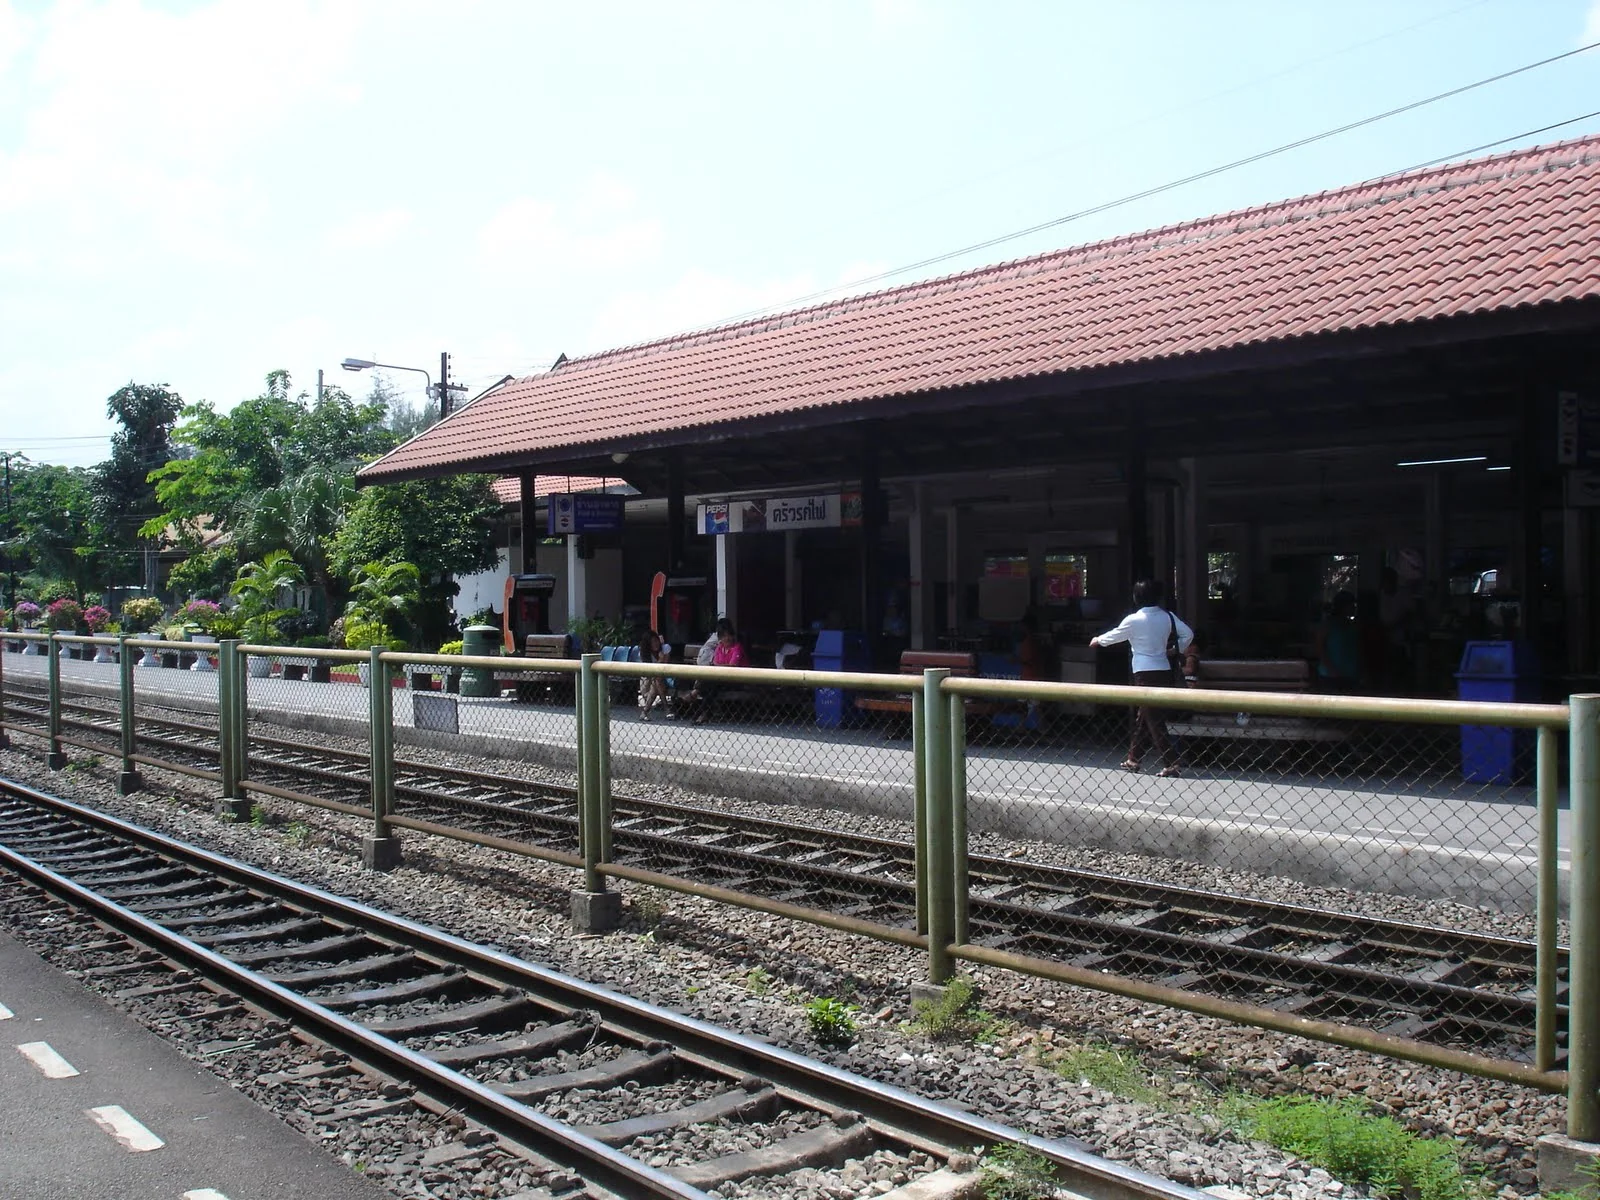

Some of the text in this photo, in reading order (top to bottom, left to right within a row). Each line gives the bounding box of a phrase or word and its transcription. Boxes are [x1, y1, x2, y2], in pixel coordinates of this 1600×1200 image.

[706, 504, 728, 514] PEPSI
[773, 498, 826, 522] ครัวรถไฟ
